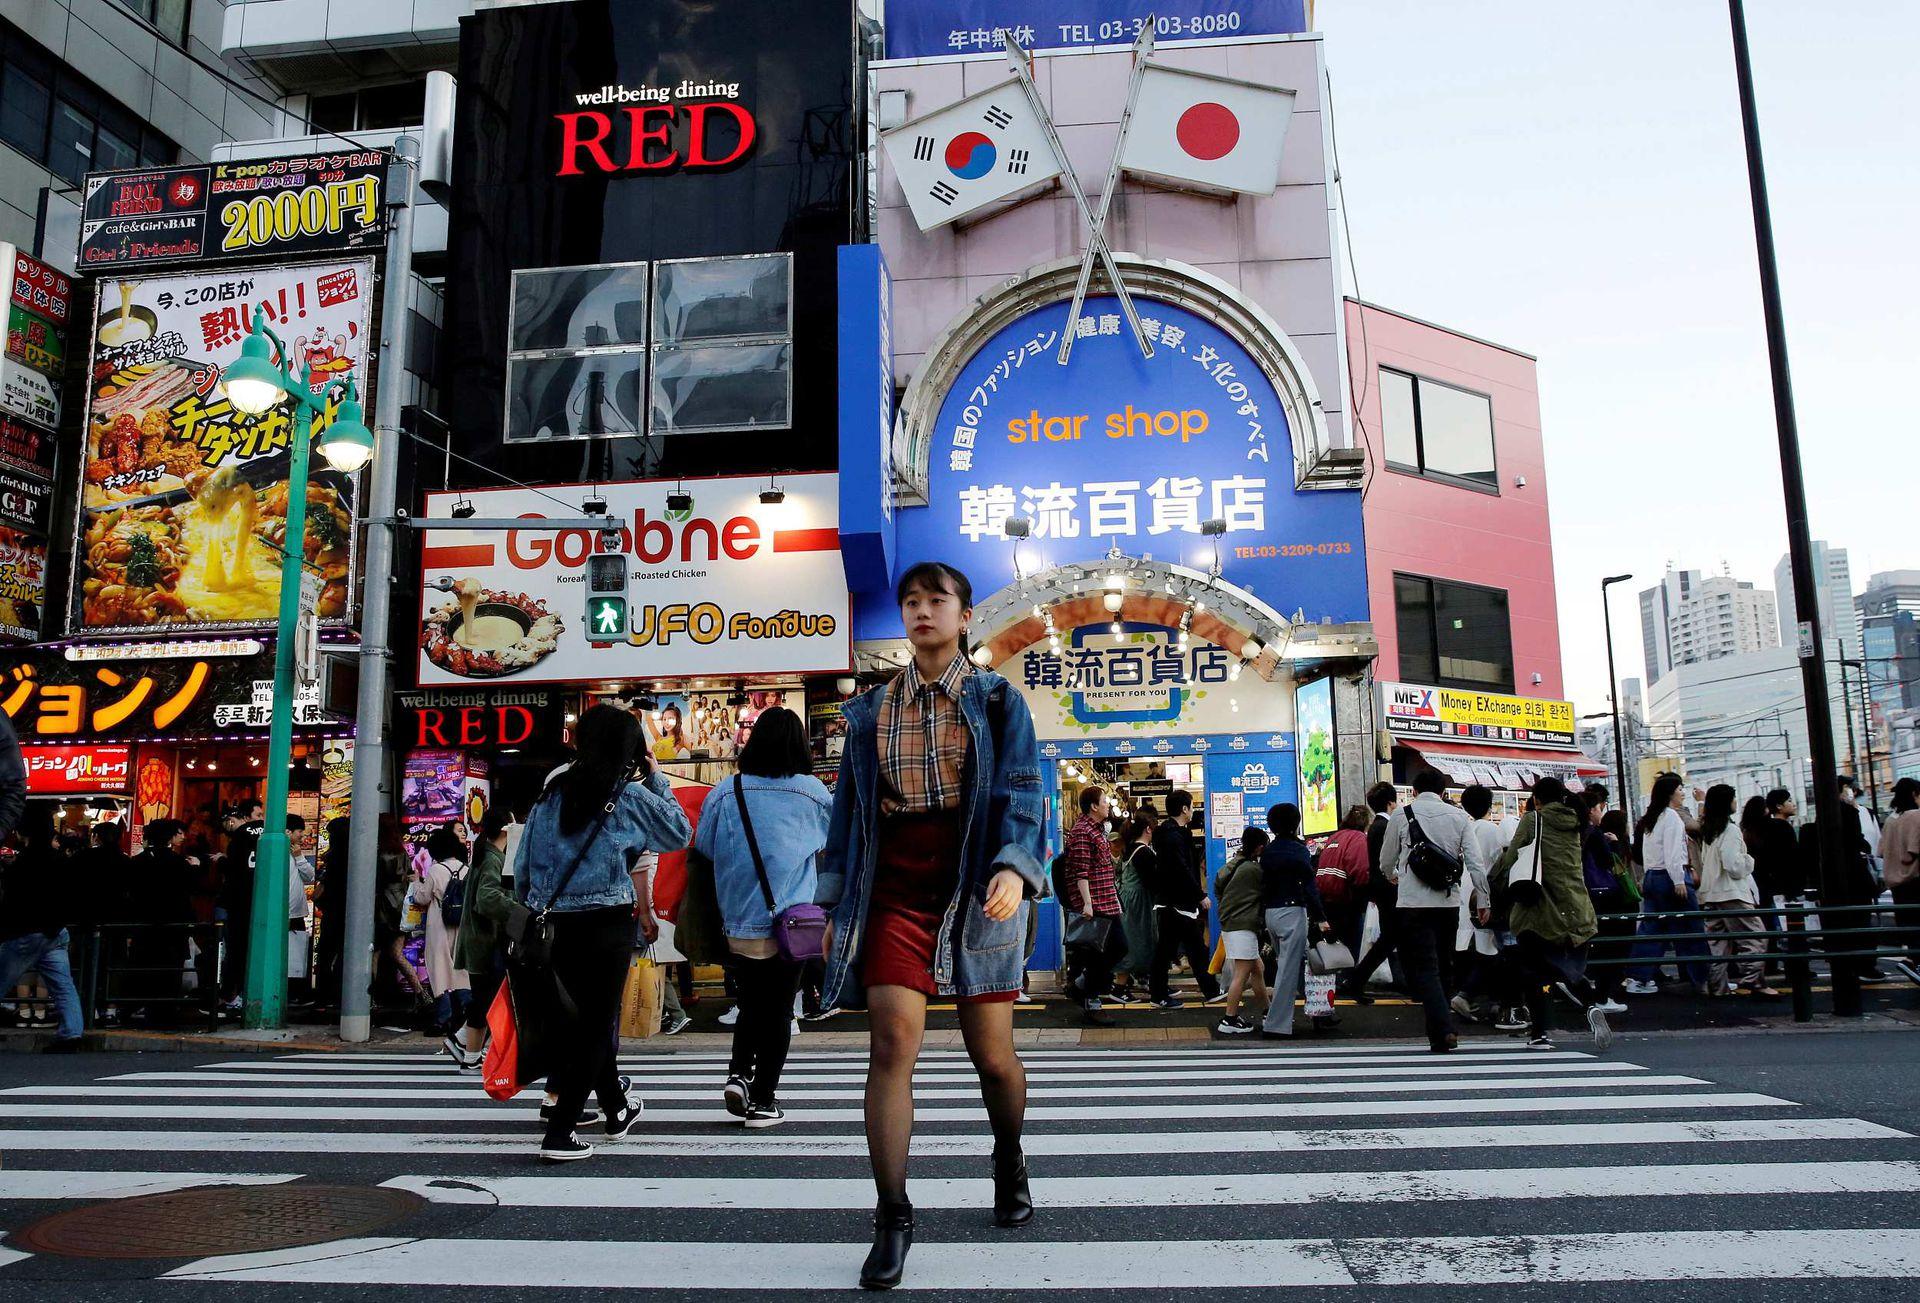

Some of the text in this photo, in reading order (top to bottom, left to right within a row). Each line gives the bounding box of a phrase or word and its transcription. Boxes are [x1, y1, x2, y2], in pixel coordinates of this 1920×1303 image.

[948, 25, 1035, 50] 年中無休
[1059, 12, 1240, 42] TEL 03-303-8080
[576, 79, 740, 106] well-being dining
[553, 102, 757, 177] RED
[89, 180, 102, 189] 4F
[120, 183, 158, 202] BOY
[111, 197, 163, 216] FRIEND
[221, 174, 380, 251] 2000円
[84, 224, 97, 233] 3F
[129, 239, 199, 259] Friends
[29, 262, 68, 295] ソウル
[16, 278, 65, 318] 整体院
[157, 278, 255, 310] 今、この店が
[1007, 404, 1209, 444] star shop
[104, 464, 166, 490] チキンフェア
[959, 474, 1268, 543] 韓流百貨店
[1235, 542, 1351, 559] TEL:03-3209-0733
[634, 570, 670, 580] Roasted
[671, 569, 707, 579] Chicken
[625, 602, 836, 647] UFO Fondue
[1024, 642, 1228, 690] 韓流百貨店
[401, 689, 549, 708] well-being dining
[1086, 691, 1126, 699] PRESENT
[1394, 686, 1435, 717] MEX
[1441, 692, 1569, 720] Money EXchange 외화 환전
[416, 705, 534, 746] RED
[1389, 719, 1439, 732] Money EXchange
[1454, 713, 1466, 721] No
[1469, 714, 1513, 726] Commission
[1529, 731, 1571, 743] Money EXchange
